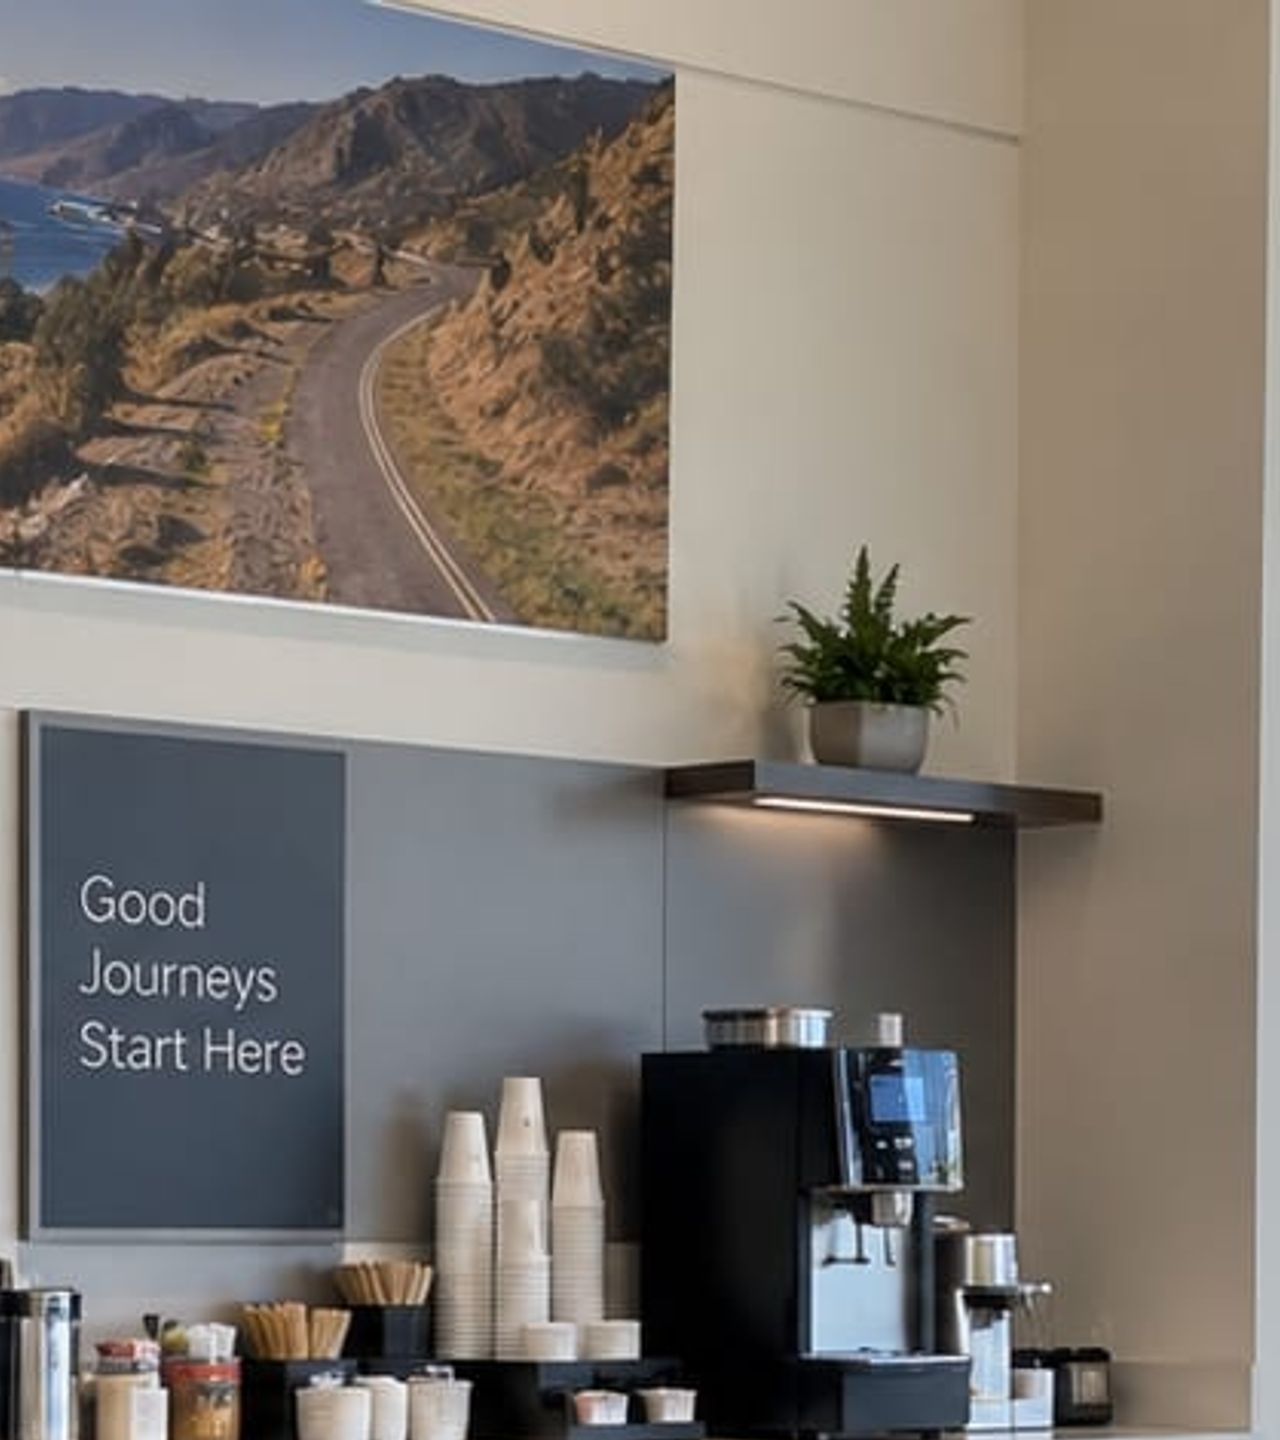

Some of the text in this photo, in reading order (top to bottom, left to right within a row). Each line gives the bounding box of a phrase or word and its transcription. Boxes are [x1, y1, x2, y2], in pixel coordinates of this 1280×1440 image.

[80, 873, 205, 929] Good
[78, 947, 278, 1011] Journeys
[80, 1020, 306, 1076] Start Here
